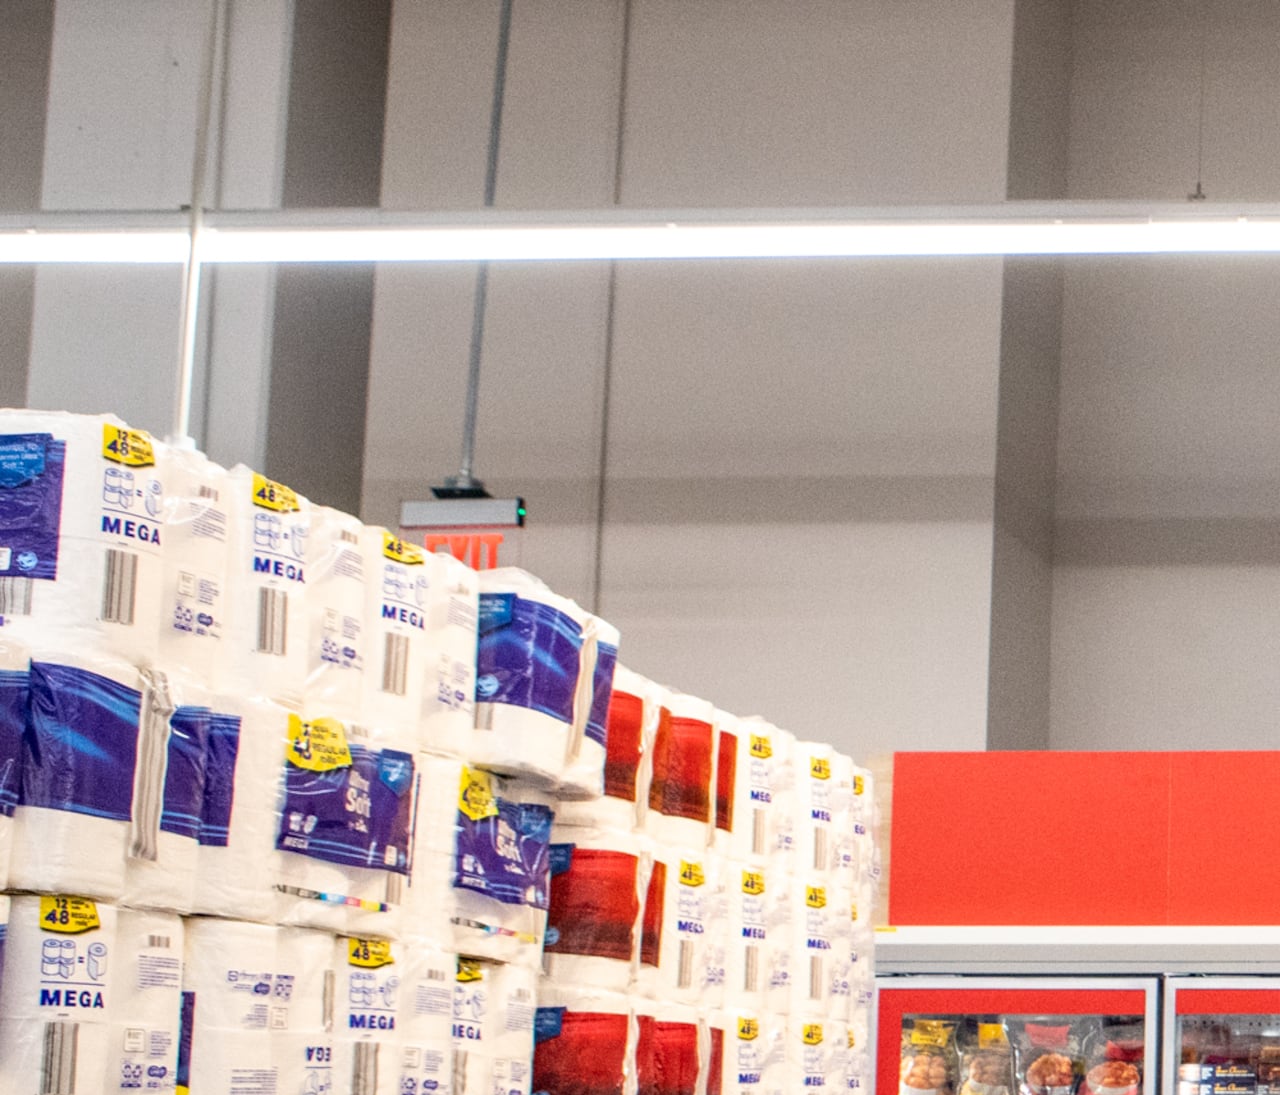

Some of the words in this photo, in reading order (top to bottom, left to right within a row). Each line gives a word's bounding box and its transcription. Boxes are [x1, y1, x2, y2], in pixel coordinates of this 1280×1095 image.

[107, 440, 129, 457] 48
[256, 487, 275, 502] 48
[102, 515, 161, 546] MEGA
[254, 556, 305, 584] MEGA
[45, 911, 70, 925] 48
[352, 948, 370, 961] 48
[40, 989, 104, 1008] MEGA
[349, 1014, 395, 1030] MEGA
